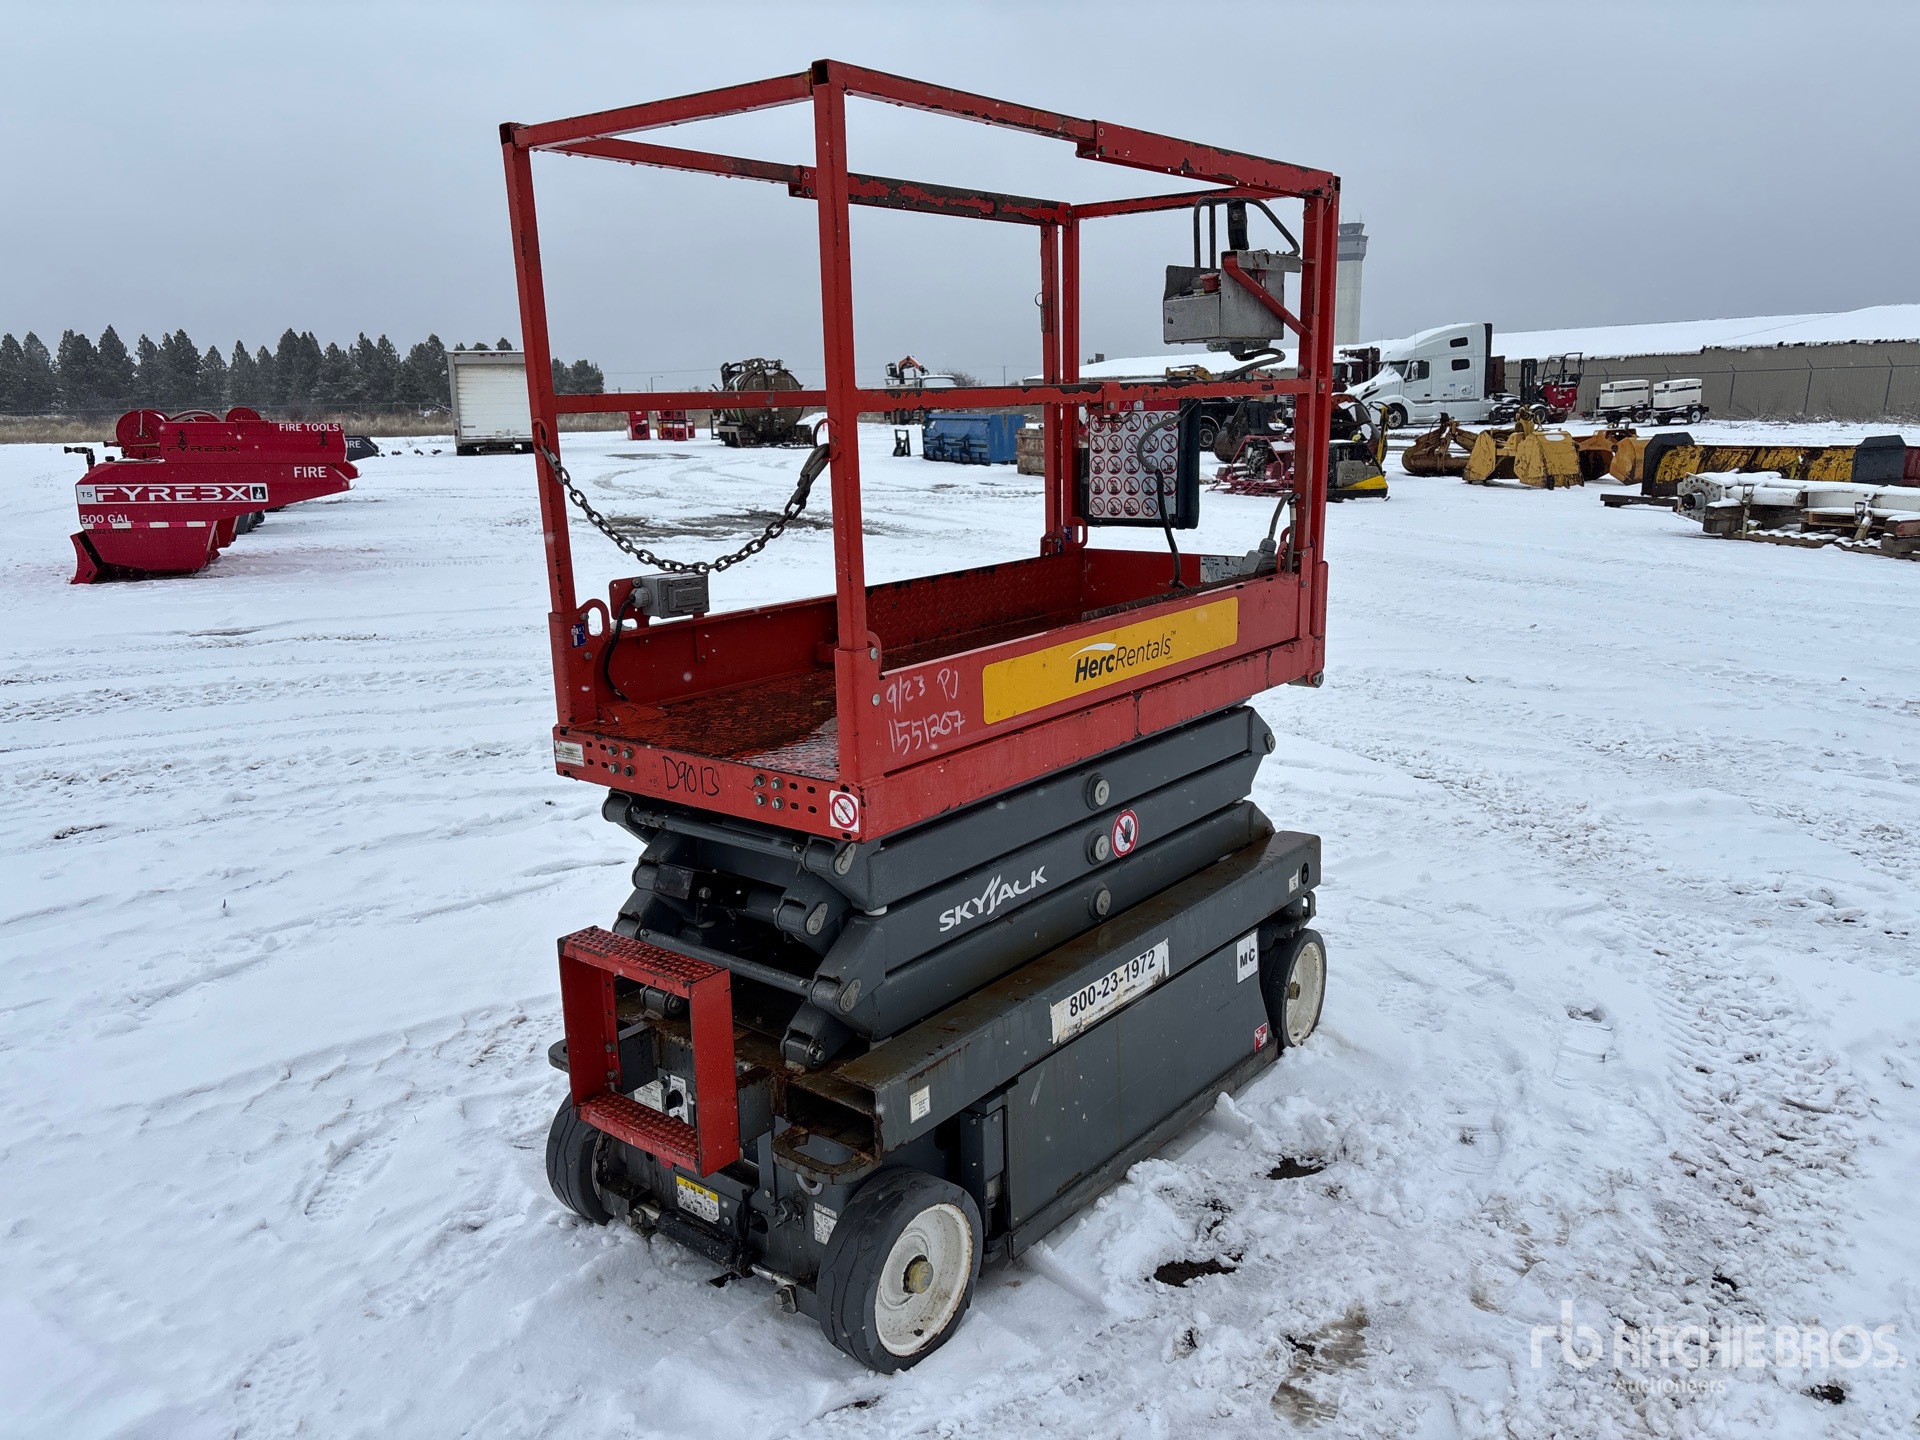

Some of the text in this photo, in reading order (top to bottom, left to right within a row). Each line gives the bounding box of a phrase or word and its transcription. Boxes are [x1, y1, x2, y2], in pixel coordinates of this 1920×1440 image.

[279, 423, 340, 432] FIRE TOOLS
[346, 440, 361, 449] IRE
[293, 466, 328, 478] FIRE
[80, 513, 134, 524] 500 GAL.
[938, 864, 1048, 933] SKYJACK
[1239, 947, 1256, 969] MC
[1069, 948, 1156, 1018] 800-23-1972
